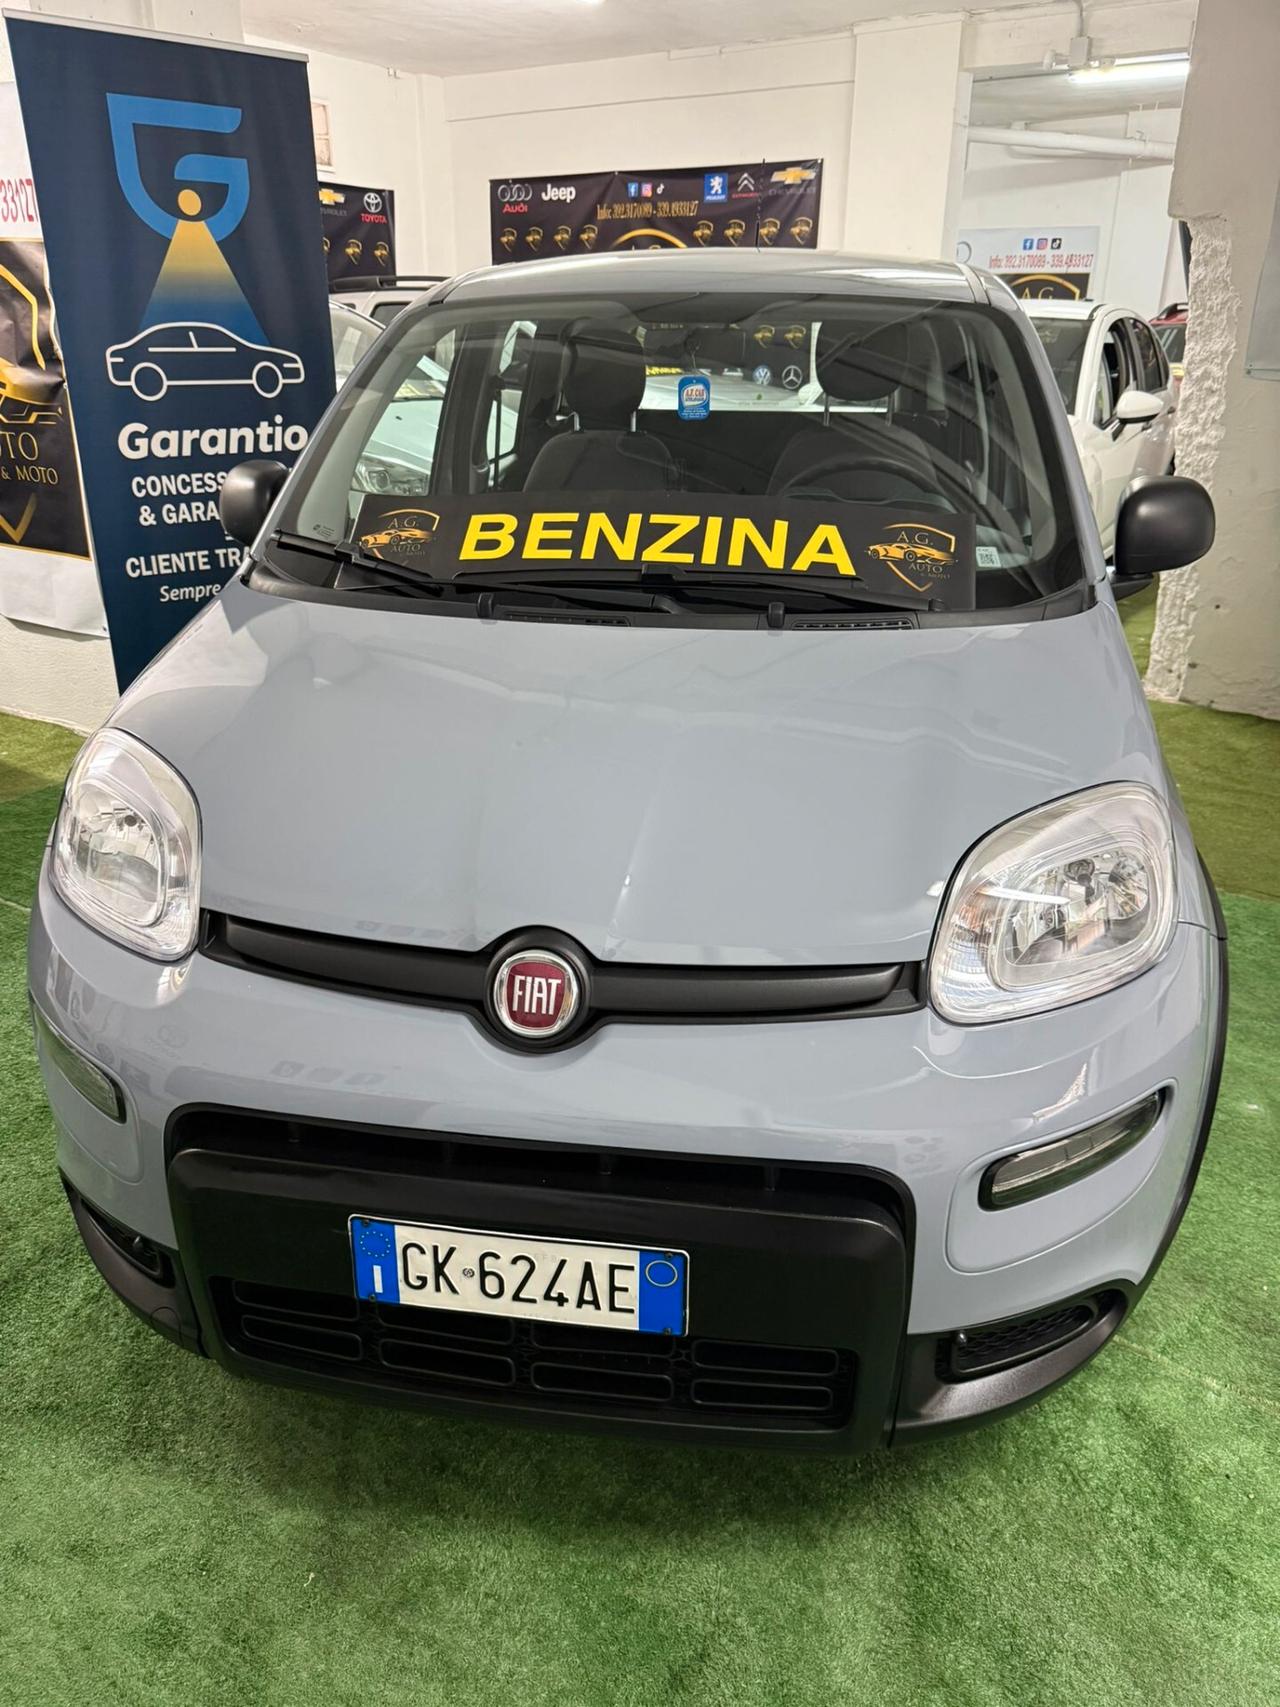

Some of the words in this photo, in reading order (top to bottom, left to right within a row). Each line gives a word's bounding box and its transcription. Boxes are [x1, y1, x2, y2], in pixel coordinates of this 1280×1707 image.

[541, 183, 576, 203] Jeep
[361, 213, 387, 224] TOYOTA
[503, 203, 528, 213] Audi
[0, 431, 39, 461] TO
[117, 414, 309, 460] Garantio
[1, 466, 11, 480] &
[15, 464, 58, 485] MOTO
[139, 505, 157, 527] &
[162, 500, 220, 525] GARA
[459, 512, 857, 576] BENZINA
[125, 550, 211, 578] CLIENTE
[908, 562, 943, 574] AUTO
[160, 583, 222, 602] Sempre
[512, 975, 562, 1015] FIAT
